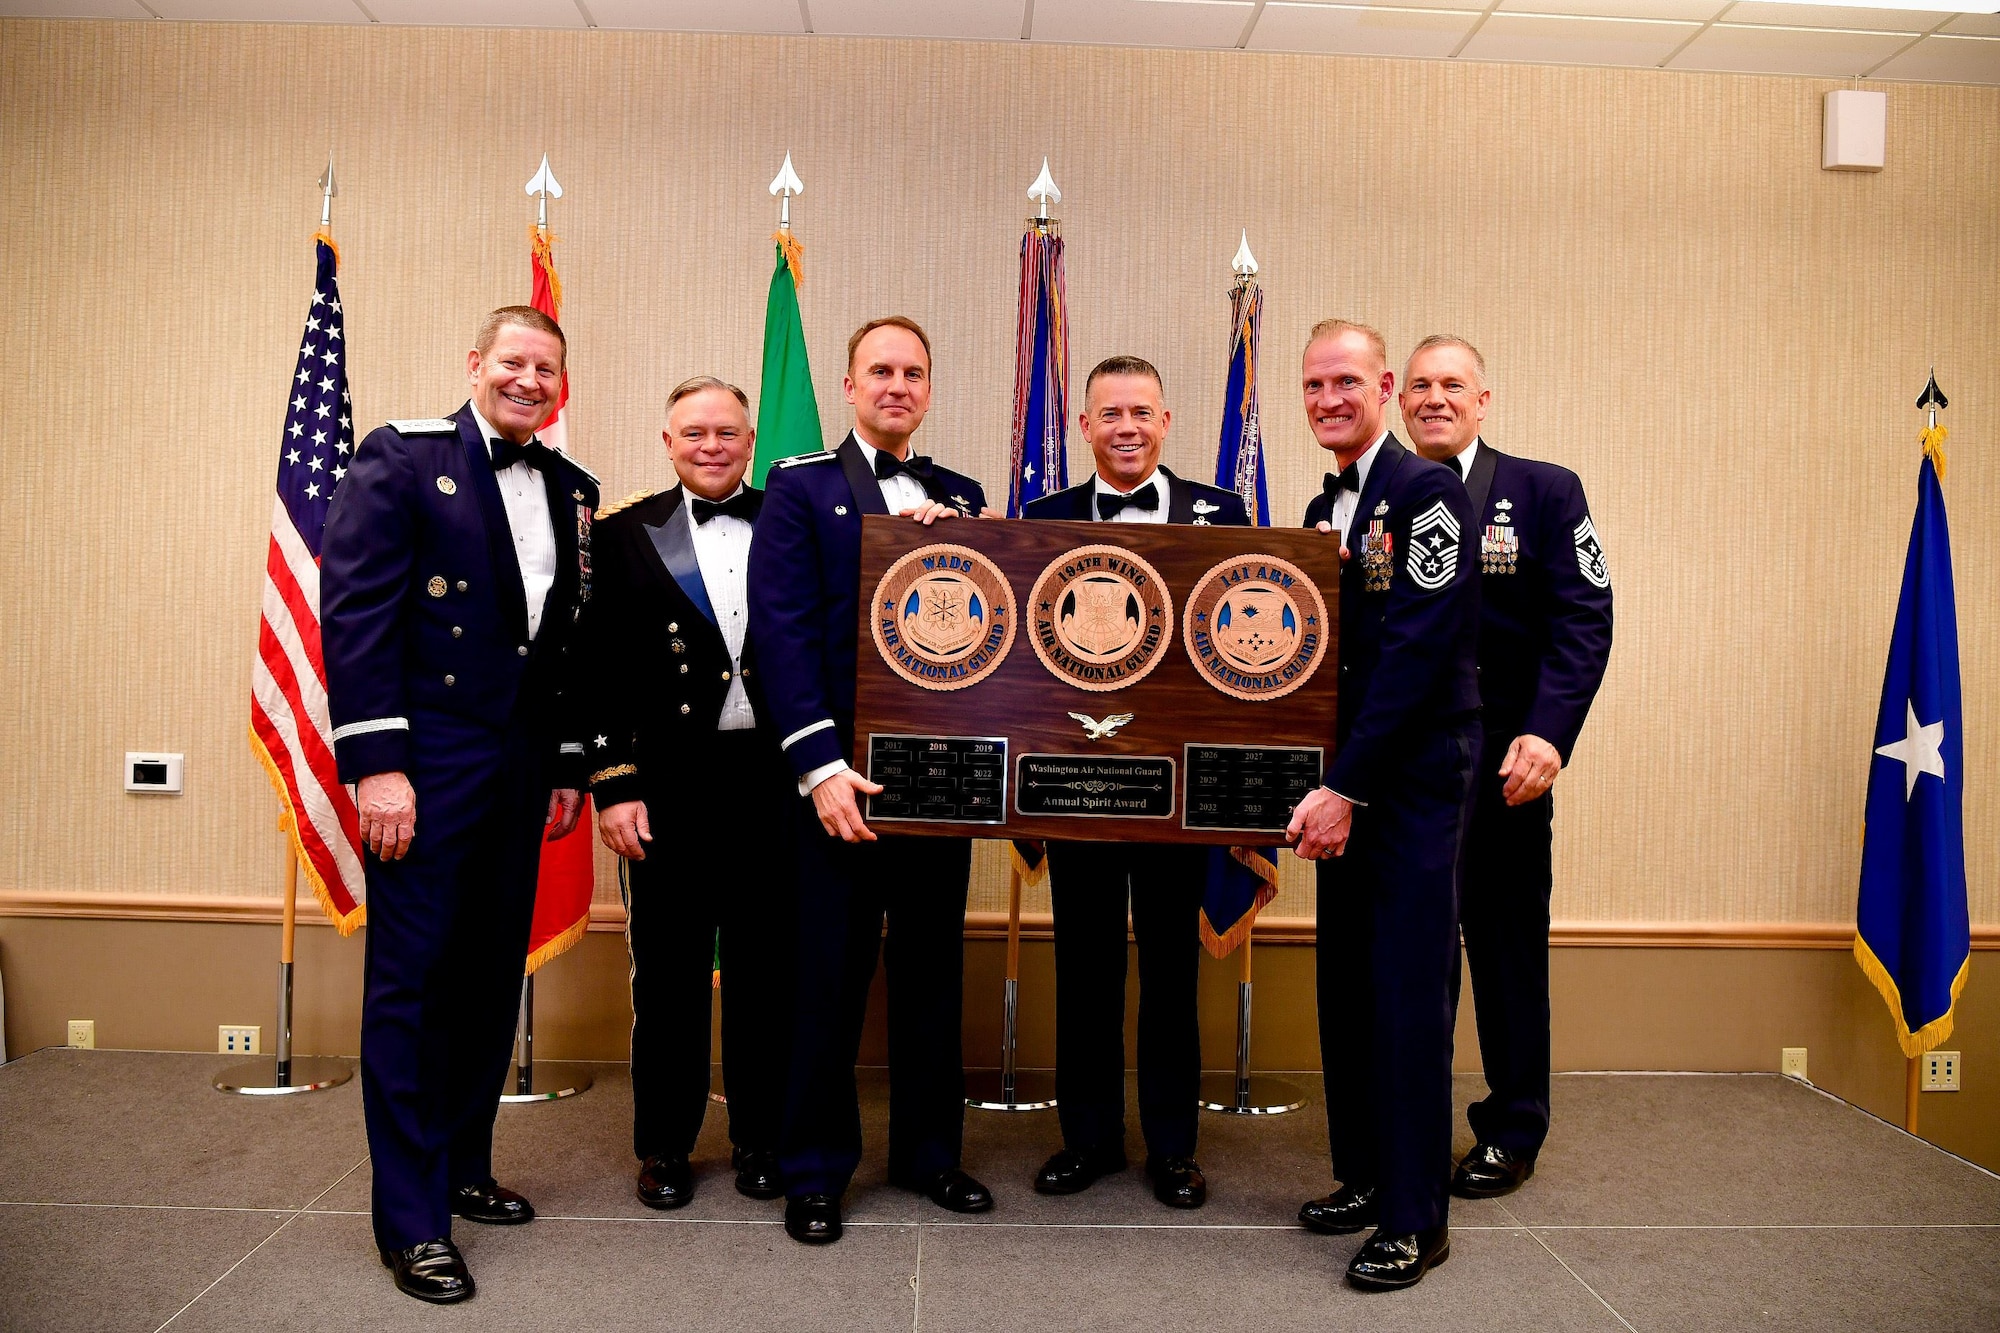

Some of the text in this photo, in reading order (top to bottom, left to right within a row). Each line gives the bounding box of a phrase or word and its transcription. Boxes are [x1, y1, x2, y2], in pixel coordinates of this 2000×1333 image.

[1248, 421, 1258, 442] JULY
[1244, 478, 1252, 503] JUNE
[922, 555, 973, 573] WADS
[1058, 557, 1147, 587] 194TH WING
[1220, 566, 1296, 589] 141 ABW
[882, 618, 1004, 678] AIR NATIONAL GUARD
[1038, 619, 1161, 679] AIR NATIONAL GUARD
[1195, 630, 1317, 689] AIR NATIONAL GUARD
[884, 741, 902, 749] 2017
[974, 744, 993, 752] 2019
[1200, 751, 1218, 759] 2026
[1290, 754, 1308, 762] 2028
[1029, 764, 1162, 776] Washington Air National Guard
[1200, 776, 1218, 784] 2029
[1289, 779, 1307, 787] 2031
[972, 796, 991, 804] 2025
[1043, 797, 1147, 808] Annual Spirit Award
[1199, 803, 1217, 811] 2032
